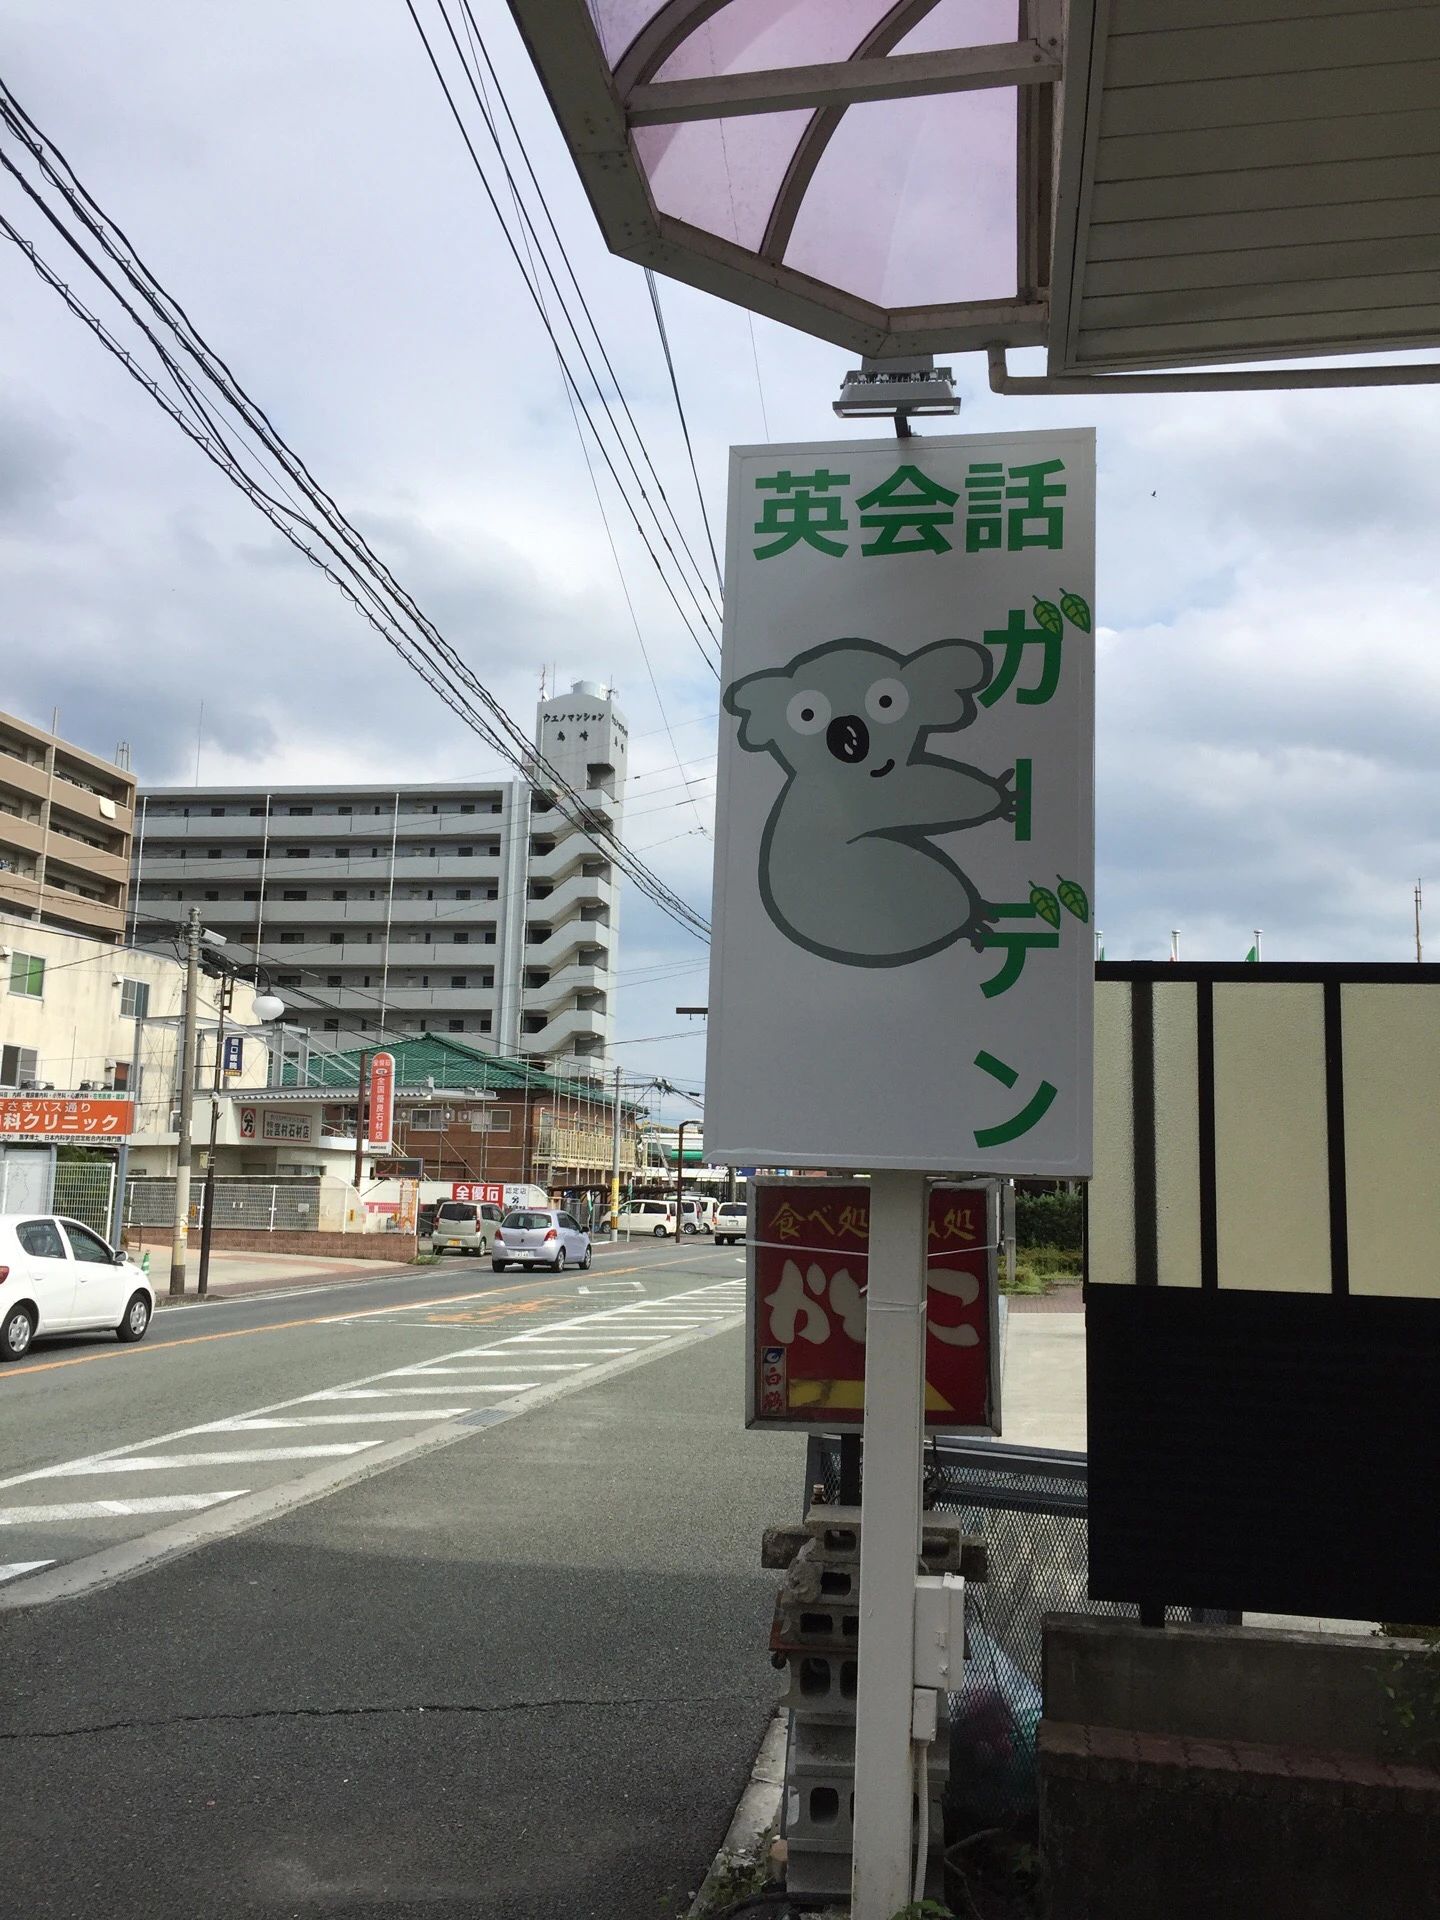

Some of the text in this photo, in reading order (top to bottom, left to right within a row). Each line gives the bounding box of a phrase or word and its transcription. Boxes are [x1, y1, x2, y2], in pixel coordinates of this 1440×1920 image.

[753, 459, 1067, 561] 英会話
[543, 712, 604, 723] ウエノマンション
[973, 590, 1090, 1149] ガーデン
[0, 1112, 119, 1131] 科クリニック
[375, 1077, 385, 1140] 全国優良石材店
[456, 1185, 500, 1201] 全優石
[768, 1202, 868, 1240] 食べ処
